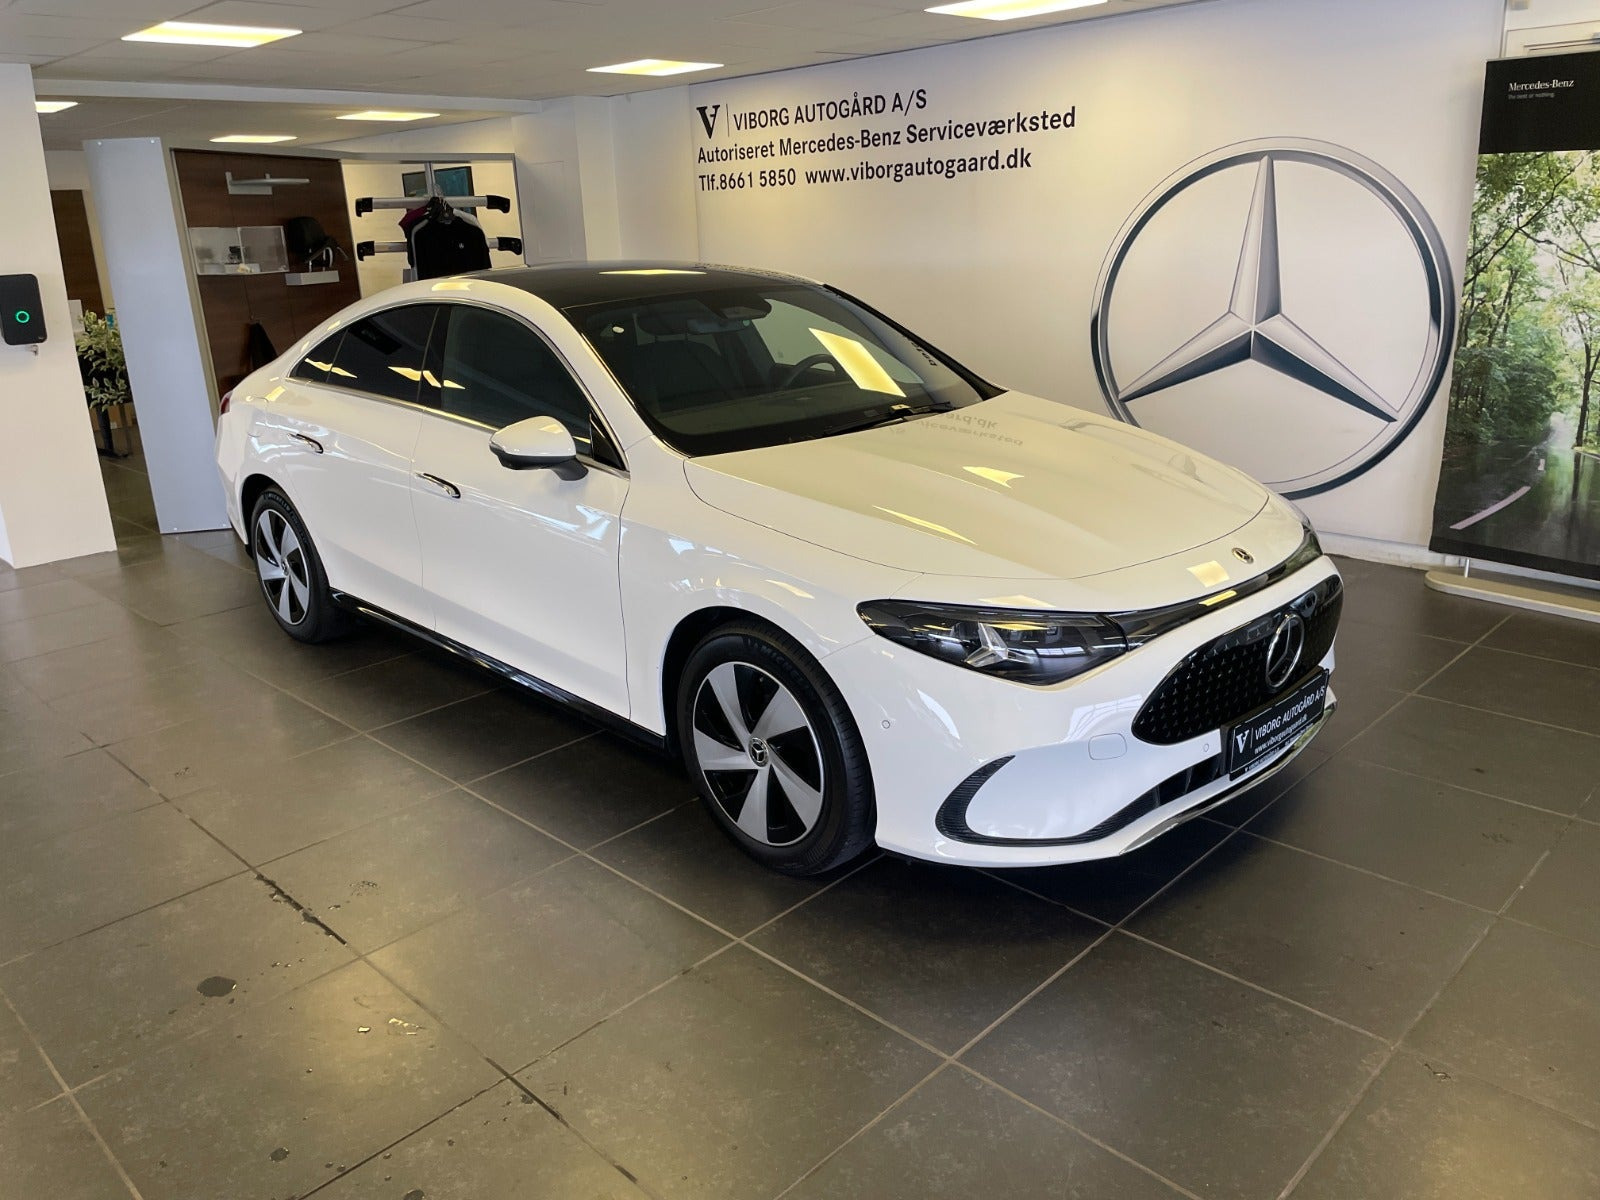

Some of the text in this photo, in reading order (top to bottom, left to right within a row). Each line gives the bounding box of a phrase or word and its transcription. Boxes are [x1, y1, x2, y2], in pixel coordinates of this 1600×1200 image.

[1509, 80, 1574, 91] Mercedes-Benz
[733, 107, 790, 131] VIBORG
[794, 91, 886, 125] AUTOGÅRD
[891, 88, 927, 116] A/S
[697, 105, 1076, 165] Autoriseret Mercedes-Benz Serviceværksted
[759, 167, 797, 188] 5850
[804, 147, 1032, 185] www.viborgautogaard.dk
[1255, 716, 1281, 740] VIBORG
[1282, 695, 1314, 724] AUTOGÅRD
[1315, 686, 1325, 703] A/S
